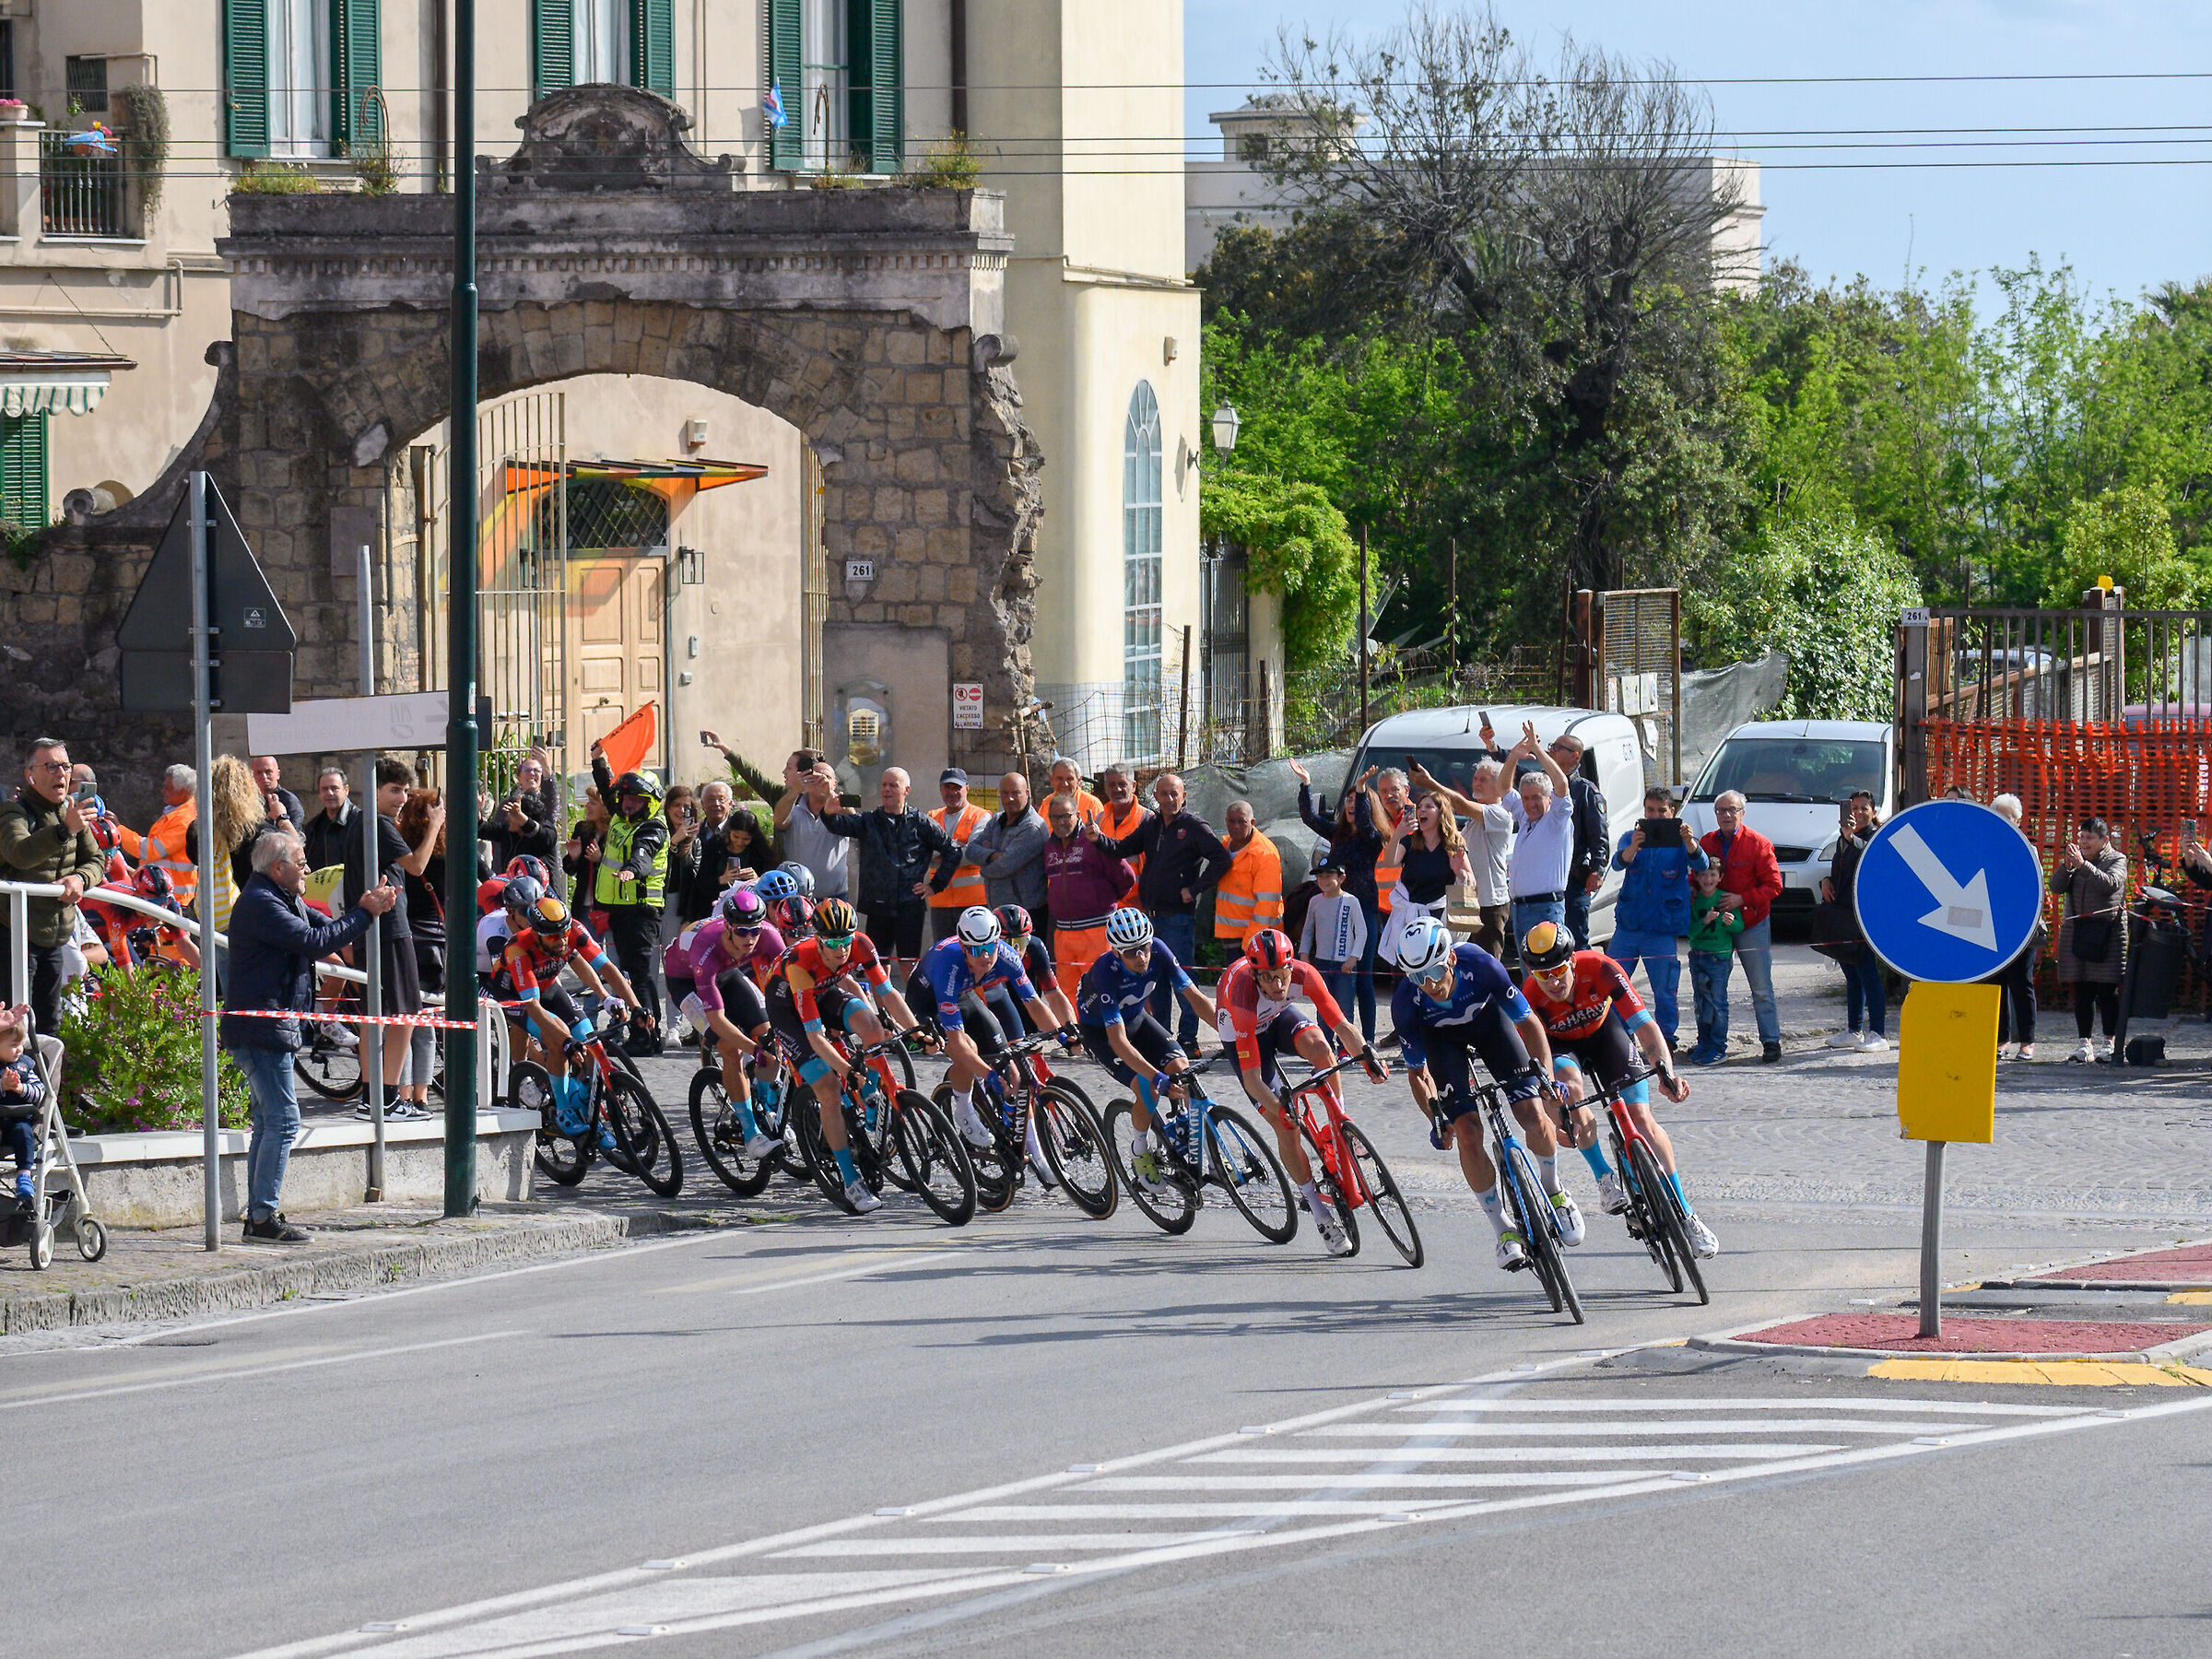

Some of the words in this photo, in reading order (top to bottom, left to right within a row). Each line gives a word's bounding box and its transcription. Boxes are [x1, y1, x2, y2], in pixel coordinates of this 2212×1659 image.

[853, 565, 869, 576] 261
[1338, 905, 1350, 957] STRENGTH
[1014, 1088, 1029, 1143] CANYON
[1189, 1108, 1199, 1165] CANYON
